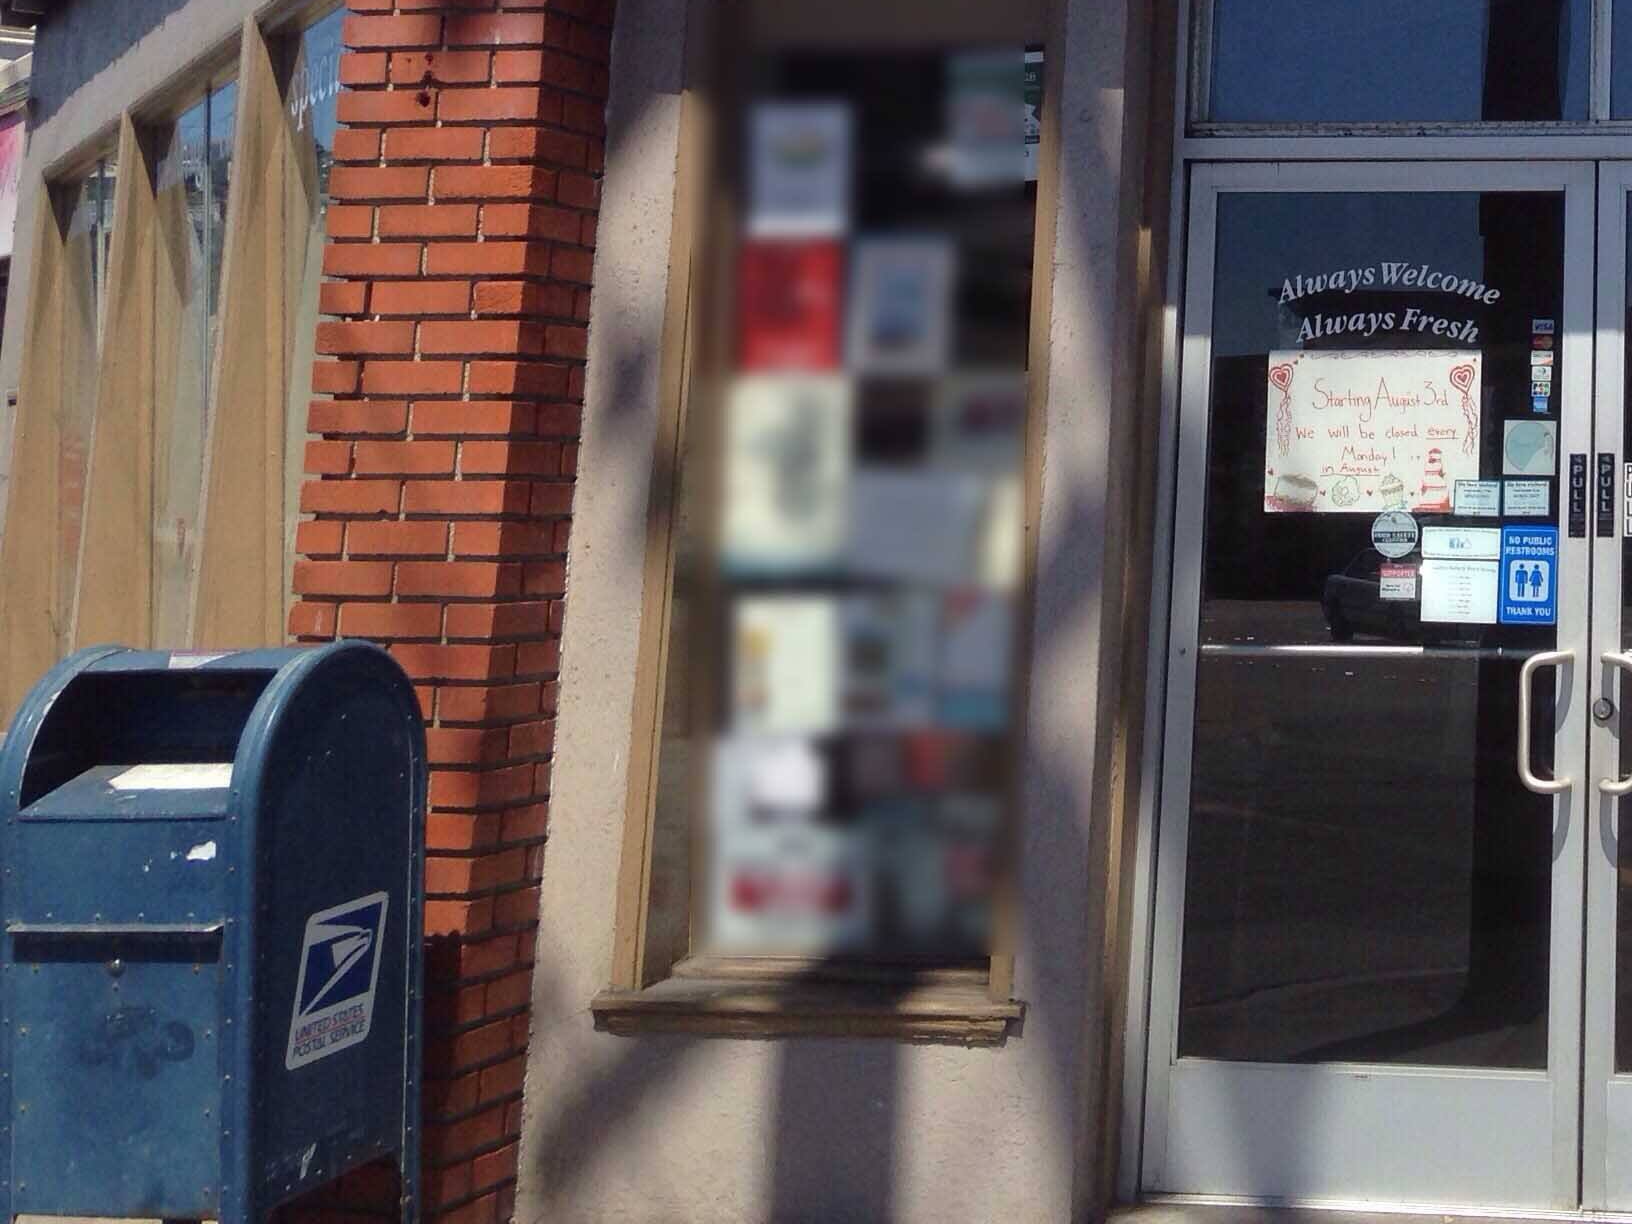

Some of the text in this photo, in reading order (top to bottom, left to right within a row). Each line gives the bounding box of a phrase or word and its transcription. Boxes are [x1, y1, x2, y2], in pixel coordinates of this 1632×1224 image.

[1278, 262, 1500, 305] Always Welcome
[1296, 308, 1479, 344] Always Fresh
[1312, 376, 1449, 422] Starting August 3rd
[1296, 424, 1458, 440] We will be closed every
[1340, 463, 1380, 476] August
[1572, 465, 1583, 513] PULL
[1600, 464, 1611, 512] PULL
[1505, 547, 1555, 556] RESTROOMS
[1508, 536, 1552, 545] NO PUBLIC
[1506, 607, 1551, 616] THANK YOU
[293, 1019, 366, 1057] POSTAL SERVICE
[295, 1003, 364, 1040] UNITED STATES
